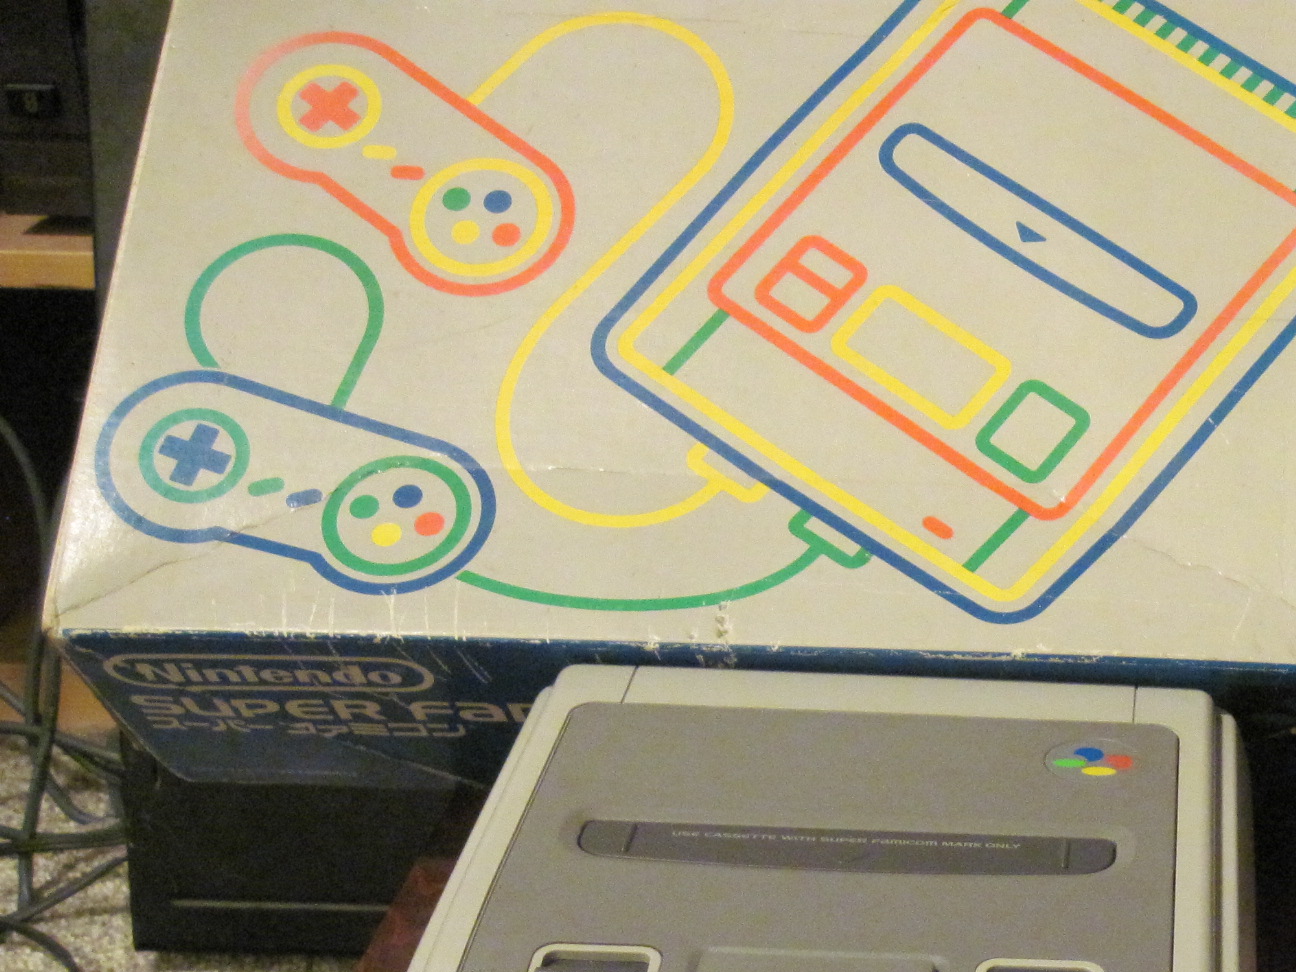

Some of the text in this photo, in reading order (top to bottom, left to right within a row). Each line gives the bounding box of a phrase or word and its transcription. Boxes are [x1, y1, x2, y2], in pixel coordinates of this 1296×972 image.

[137, 661, 402, 687] Nintendo
[132, 695, 384, 720] SUPER
[705, 832, 776, 840] CASSETTE
